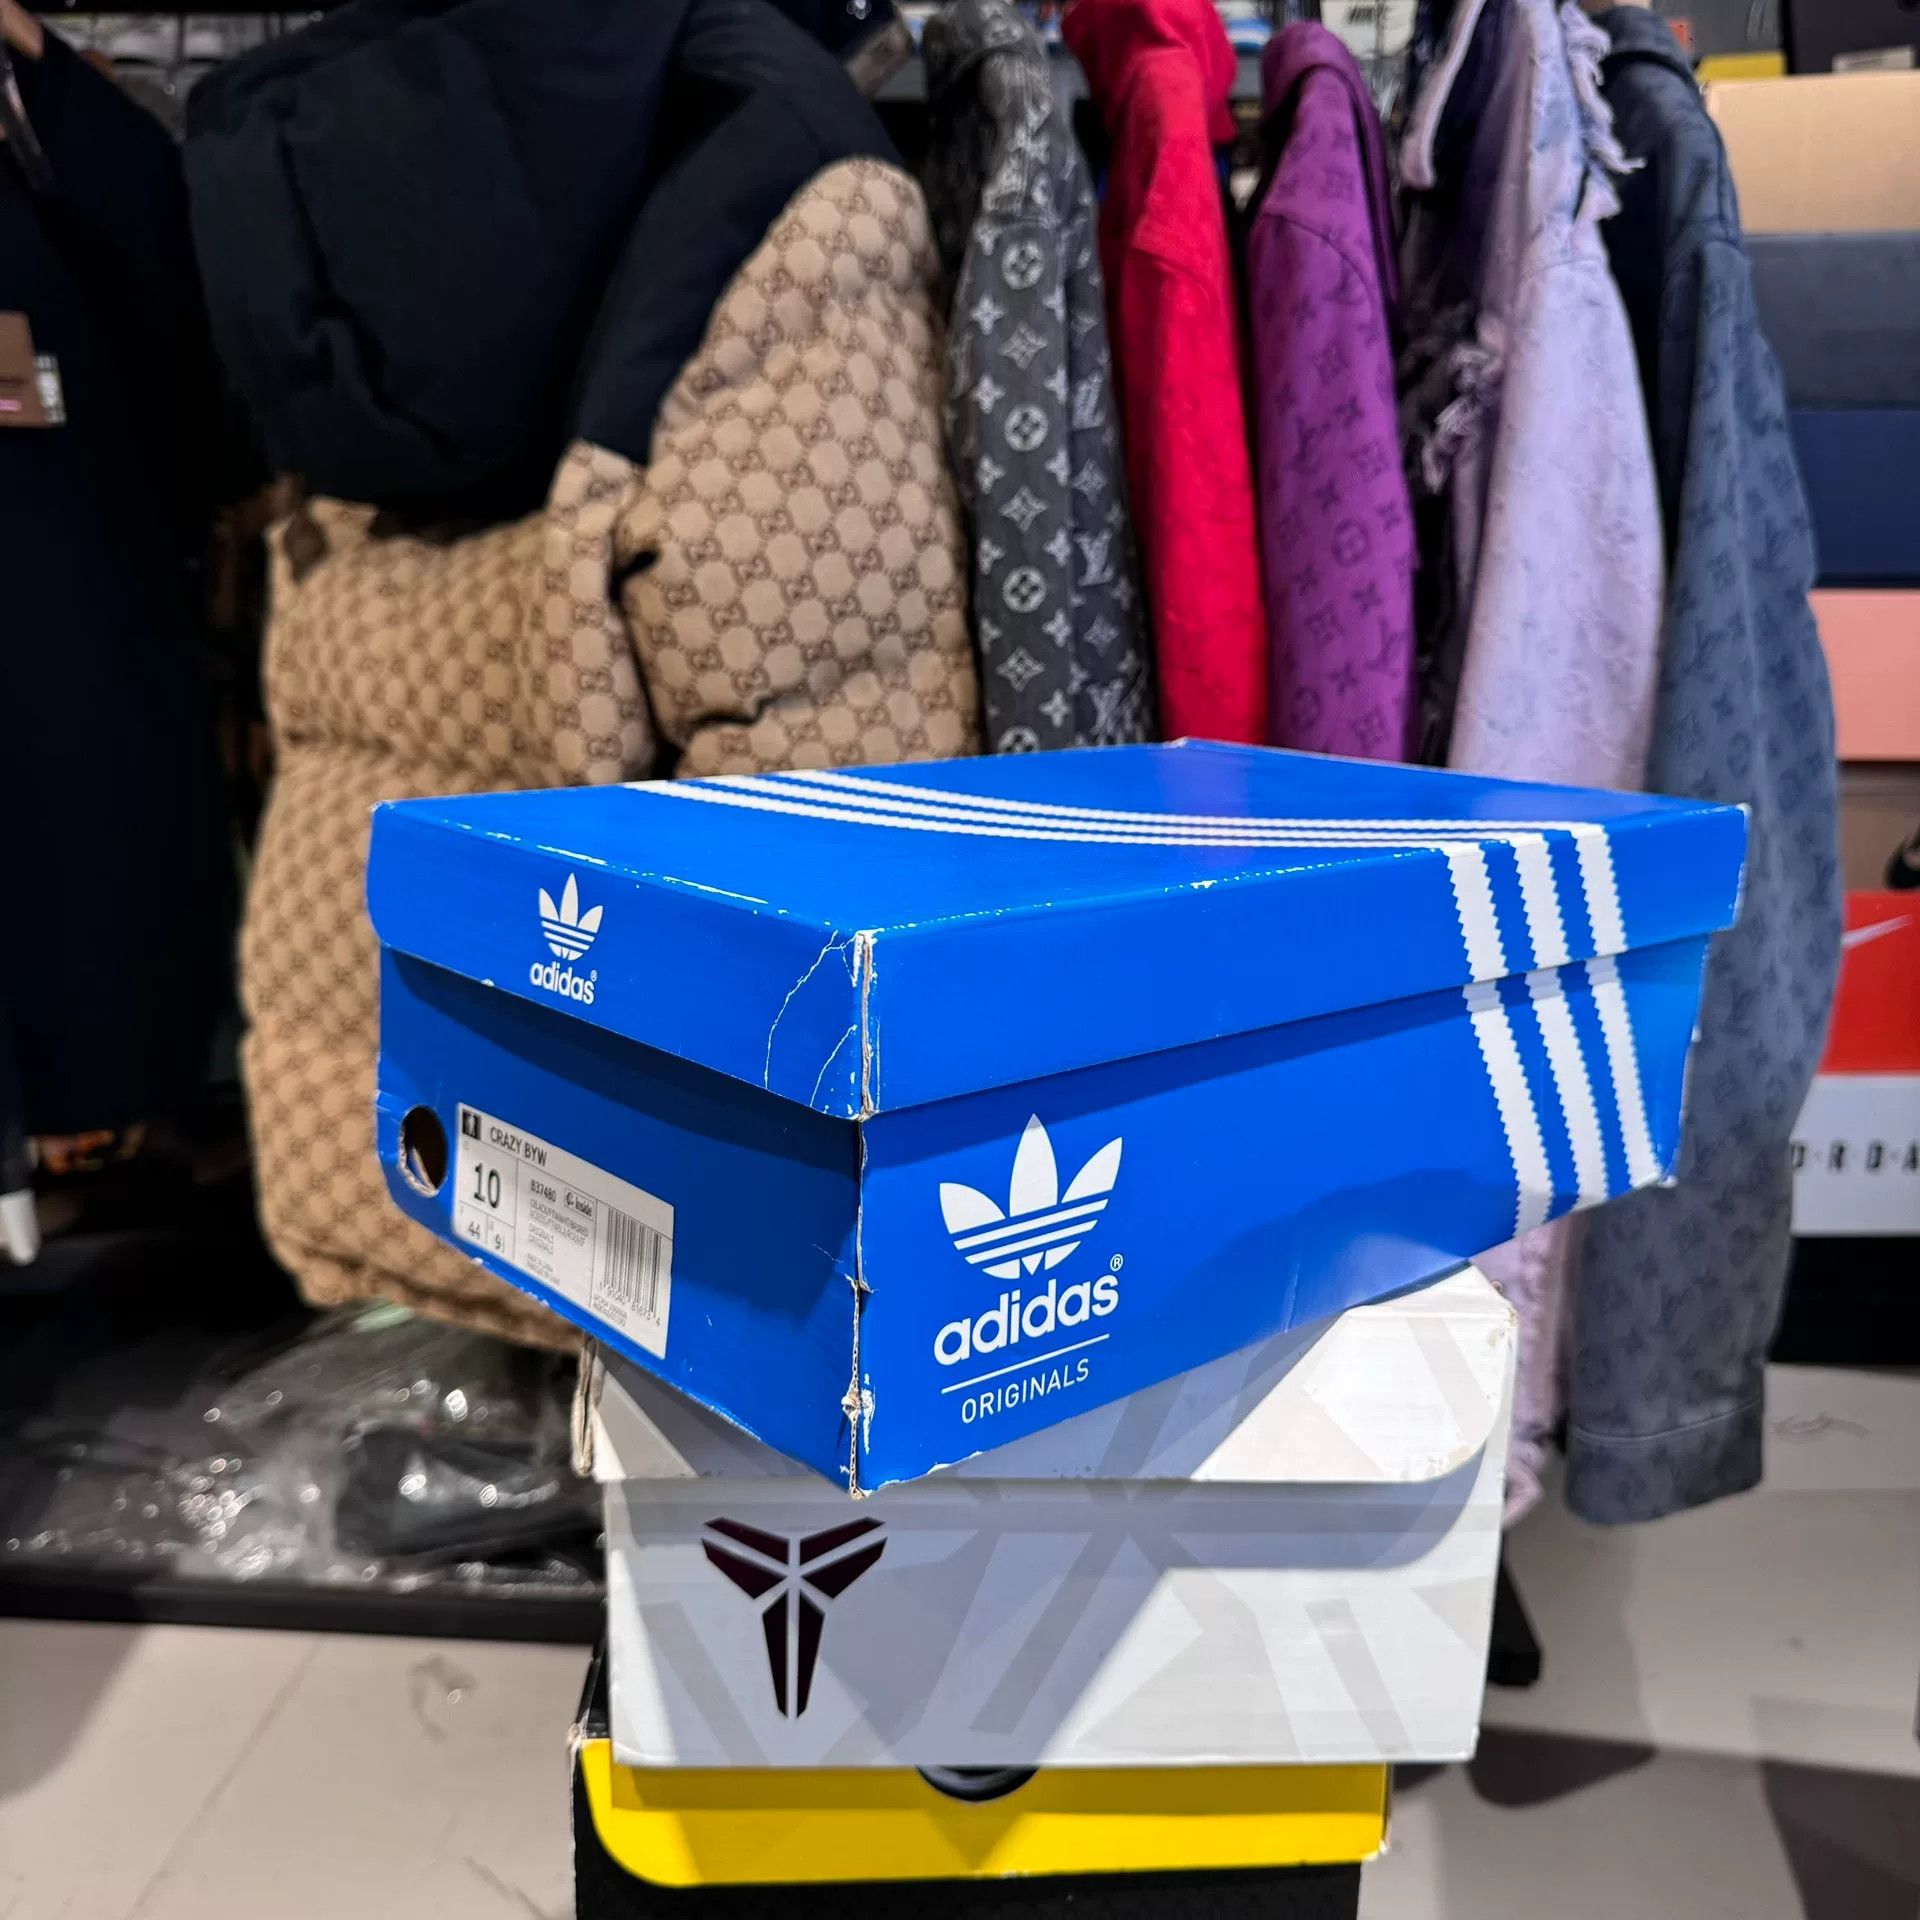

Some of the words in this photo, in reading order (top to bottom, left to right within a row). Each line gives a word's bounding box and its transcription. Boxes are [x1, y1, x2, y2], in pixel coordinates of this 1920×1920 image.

[530, 961, 595, 1005] adidas
[489, 1126, 523, 1155] CRAZY
[524, 1141, 548, 1167] BYW
[473, 1163, 501, 1209] 10
[468, 1221, 481, 1238] 44
[933, 1275, 1120, 1366] adidas
[961, 1358, 1090, 1424] ORIGINALS
